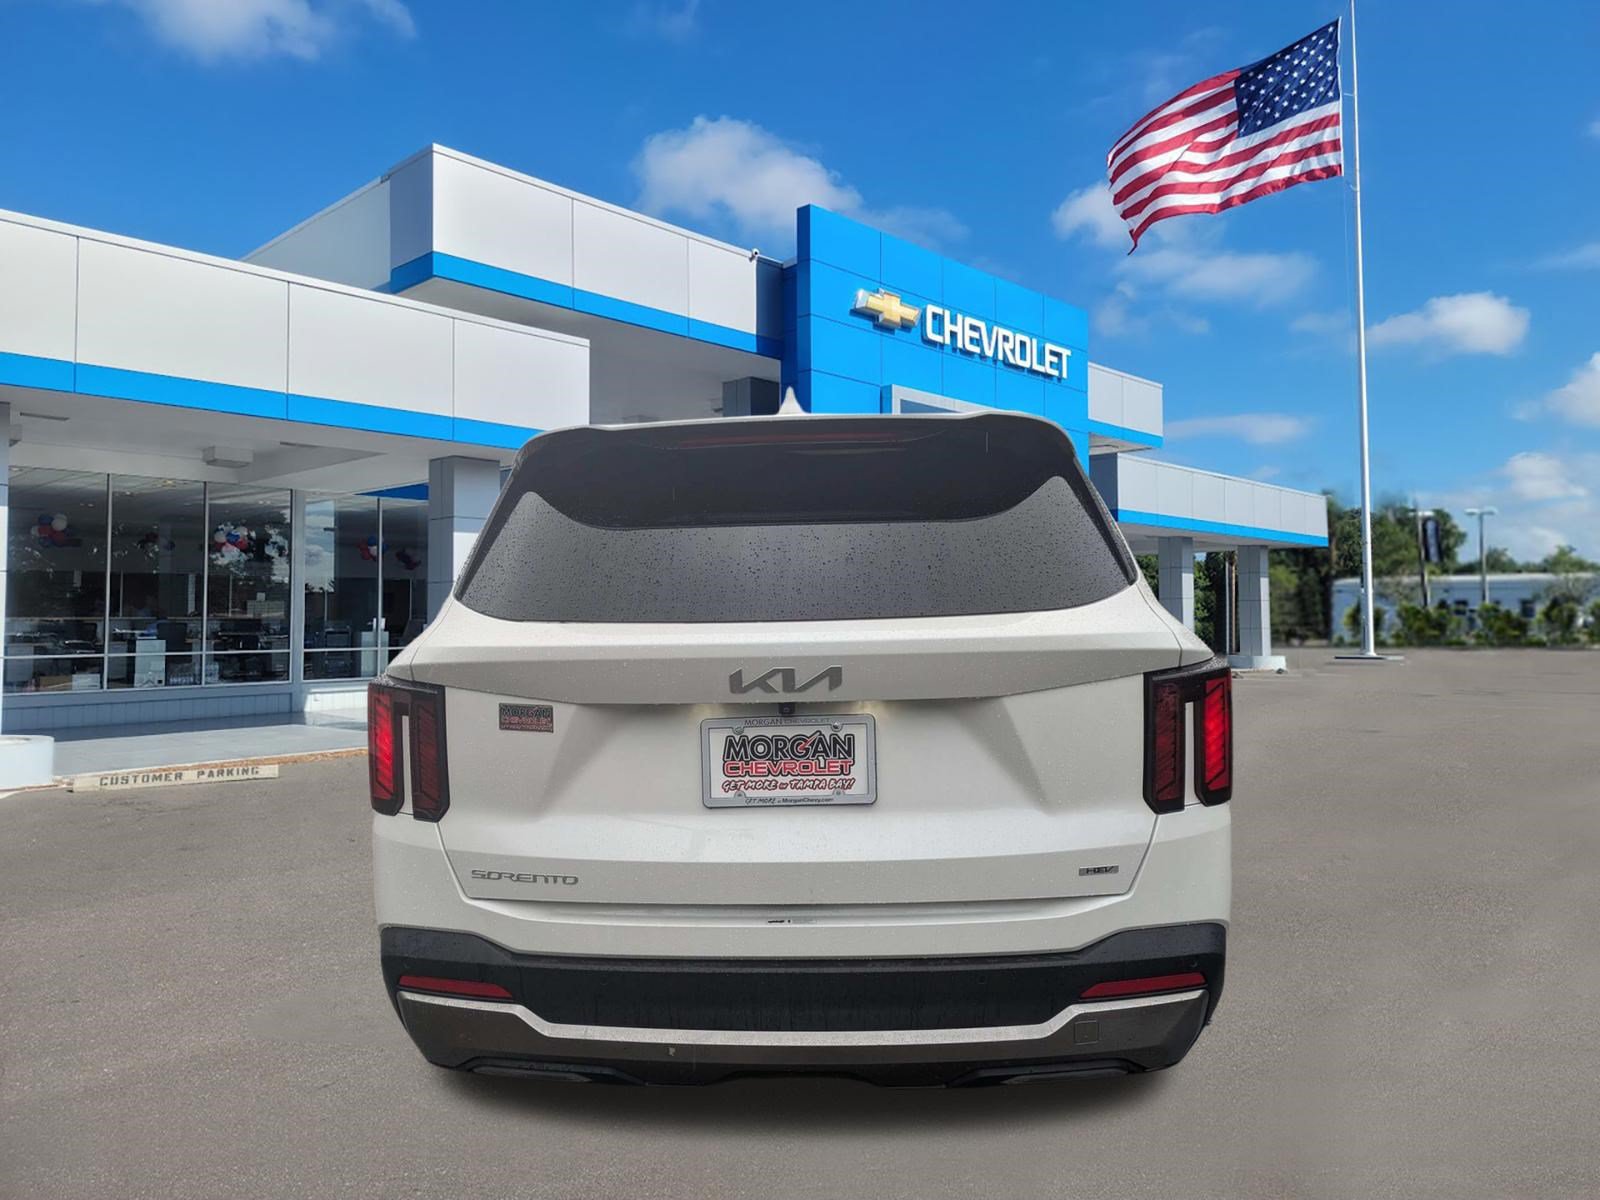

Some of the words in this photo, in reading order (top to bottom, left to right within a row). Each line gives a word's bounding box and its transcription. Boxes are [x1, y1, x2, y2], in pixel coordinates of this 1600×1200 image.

[926, 304, 1072, 379] CHEVROLET
[744, 718, 782, 726] MORGAN
[723, 730, 855, 760] MORGAN
[99, 772, 183, 786] CUSTOMER
[197, 766, 259, 779] PARKING
[723, 759, 855, 777] CHEVROLET
[722, 780, 744, 793] GET
[744, 779, 777, 791] MORE
[789, 778, 826, 791] TAMPA
[471, 869, 579, 885] SORENTO
